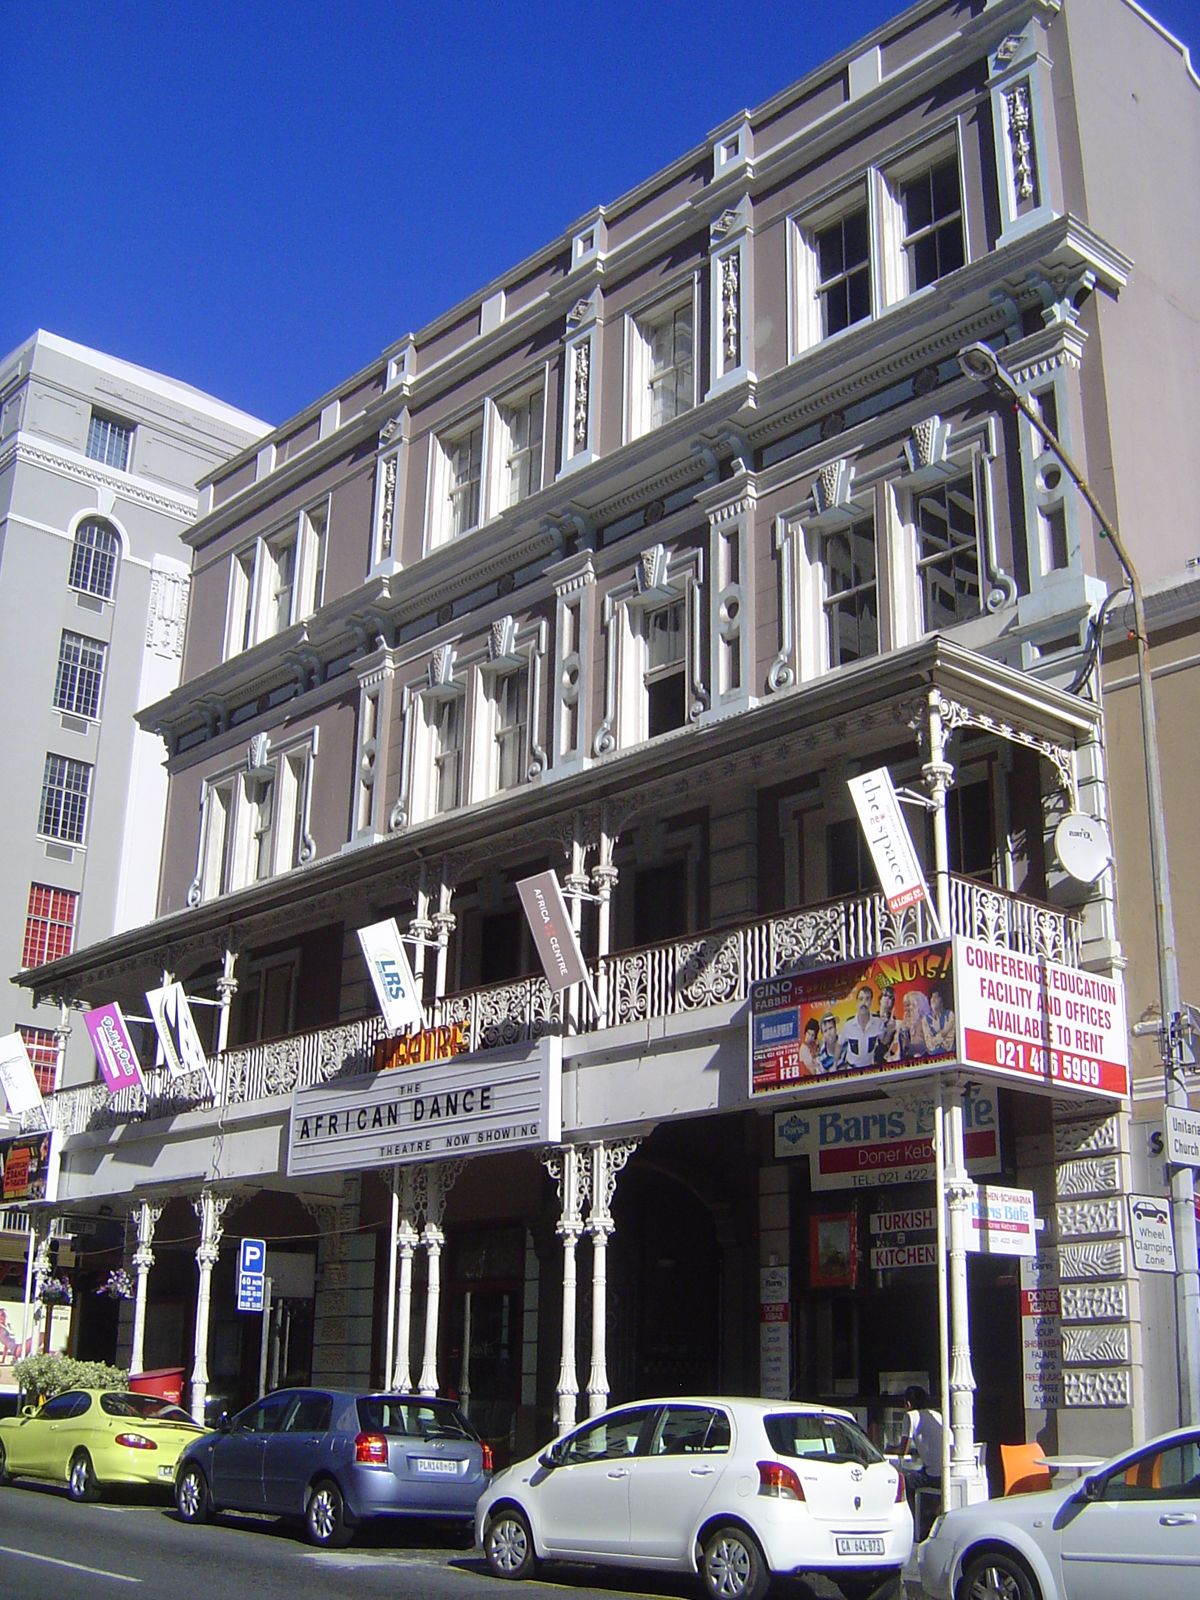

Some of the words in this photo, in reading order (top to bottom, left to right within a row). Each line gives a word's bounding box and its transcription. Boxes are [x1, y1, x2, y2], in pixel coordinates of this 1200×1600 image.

[534, 888, 551, 924] AFRICA
[550, 936, 568, 976] CENTRE
[381, 960, 405, 1001] LRS
[755, 981, 793, 999] GINO
[755, 995, 791, 1010] FABBRI
[980, 977, 1032, 1010] FACILITY
[1037, 993, 1061, 1016] AND
[1066, 1000, 1111, 1030] OFFICES
[102, 1017, 122, 1051] Daddy's
[988, 1008, 1053, 1043] AVAILABLE
[1057, 1025, 1072, 1047] TO
[1076, 1030, 1104, 1055] RENT
[779, 1054, 799, 1067] 1-12
[996, 1039, 1024, 1069] 021
[1063, 1055, 1100, 1086] 5999
[780, 1066, 799, 1080] FEB
[400, 1084, 421, 1095] THE
[300, 1103, 399, 1140] AFRICAN
[413, 1087, 493, 1122] DANCE
[380, 1140, 431, 1156] THEATRE
[446, 1134, 470, 1148] NOW
[477, 1124, 538, 1143] SHOWING
[1174, 1138, 1199, 1156] Church
[858, 1149, 900, 1165] Doner
[851, 1174, 875, 1187] TEL:
[878, 1172, 900, 1184] 021
[904, 1168, 928, 1180] 422
[877, 1211, 932, 1231] TURKISH
[1139, 1227, 1165, 1240] Wheel
[245, 1246, 261, 1266] P
[1134, 1240, 1173, 1256] Clamping
[876, 1247, 936, 1266] KITCHEN
[1145, 1254, 1165, 1266] Zone
[1027, 1291, 1059, 1302] DONER
[1029, 1302, 1057, 1313] KEBAB
[1032, 1317, 1055, 1325] TOAST
[1031, 1351, 1058, 1359] FALAFEL
[1034, 1362, 1056, 1370] CHIPS
[1025, 1373, 1044, 1382] FRESH
[1032, 1384, 1059, 1393] COFFEE
[841, 1540, 850, 1552] CA
